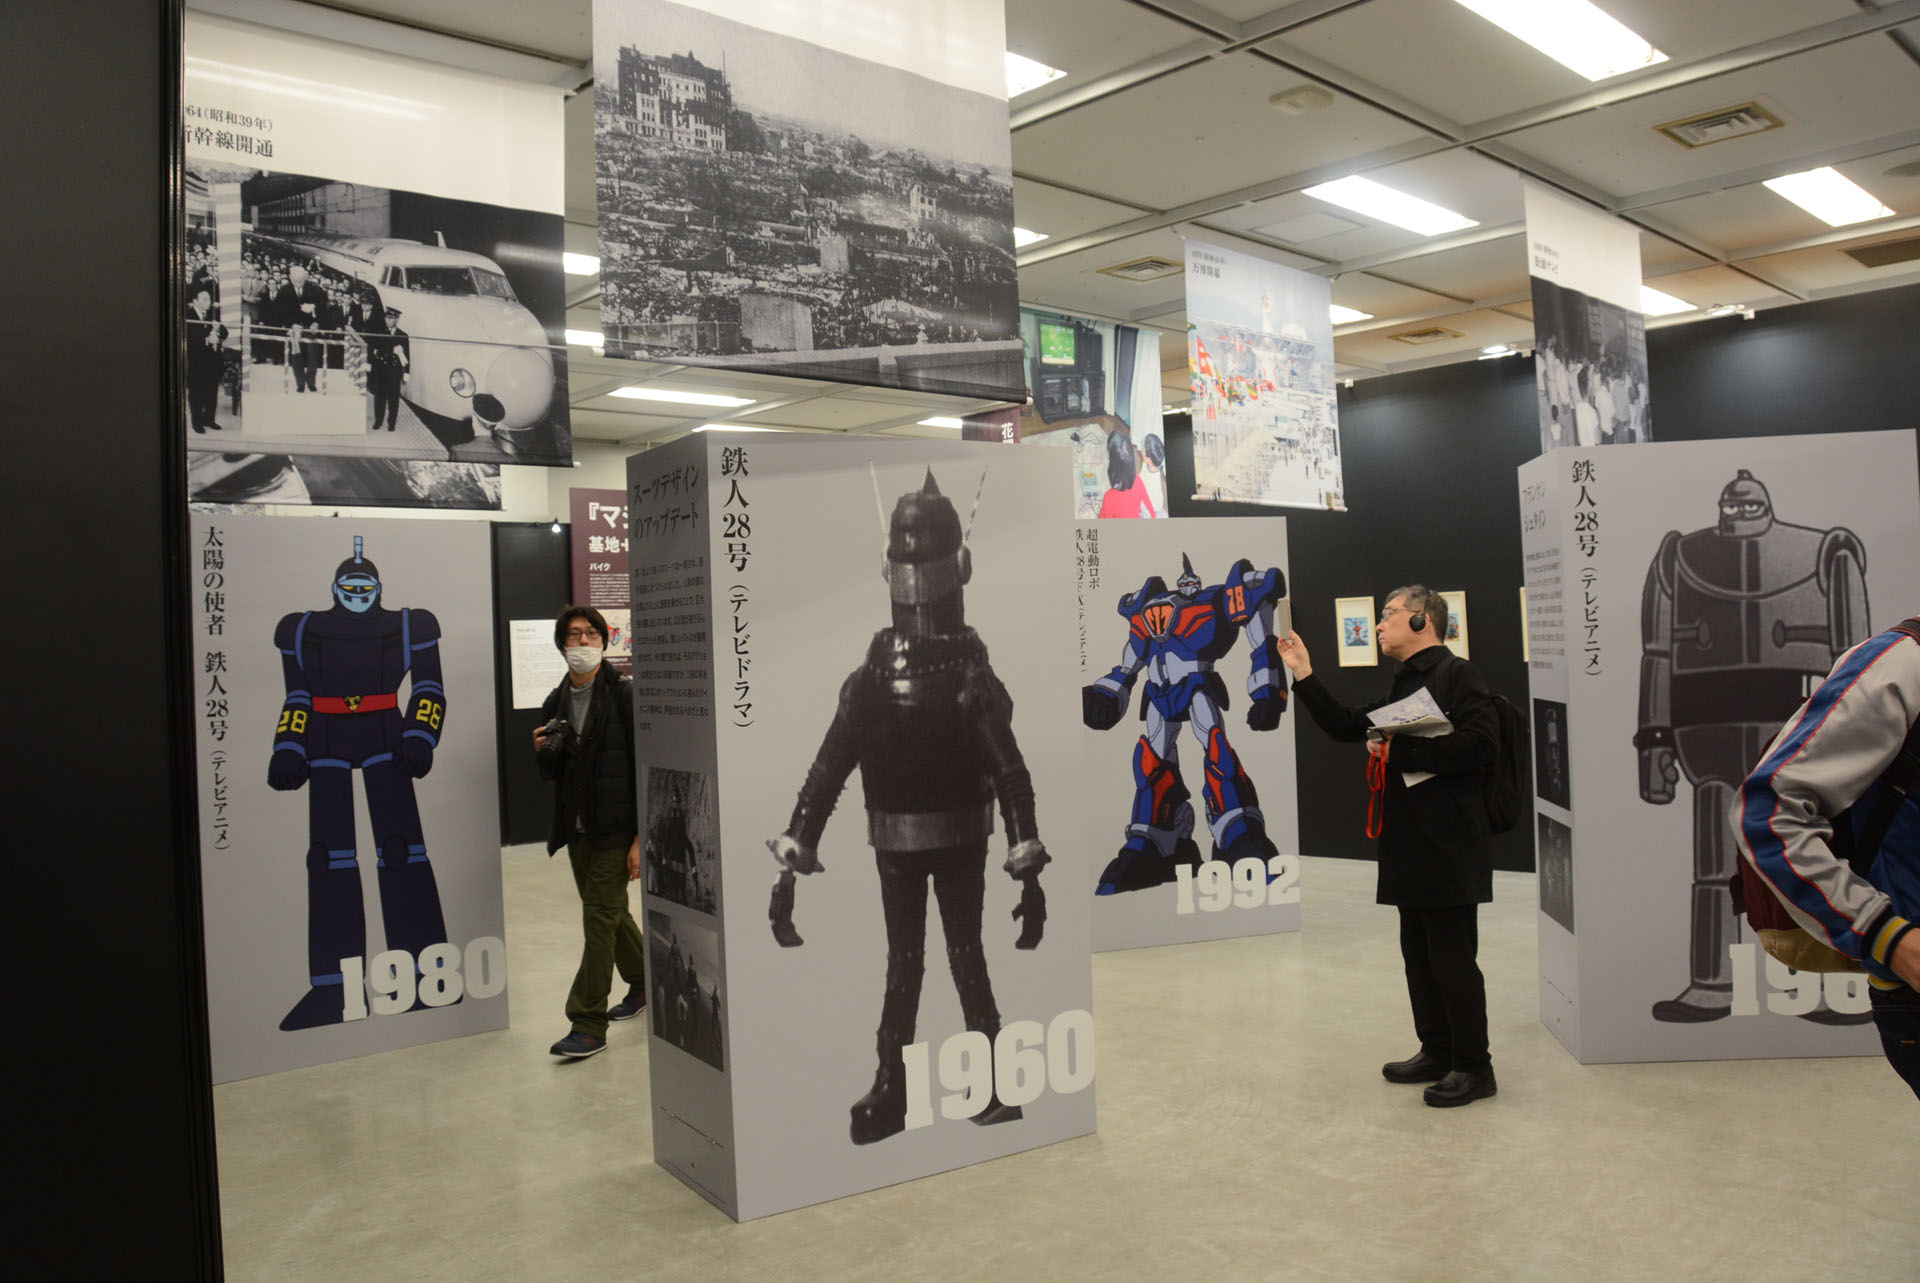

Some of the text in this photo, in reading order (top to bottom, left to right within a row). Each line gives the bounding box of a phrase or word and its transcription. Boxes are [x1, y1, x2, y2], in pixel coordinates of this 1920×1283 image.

[185, 104, 273, 131] 64（昭和39年）
[1001, 422, 1015, 443] 花
[633, 465, 700, 505] スーツデザイン
[633, 502, 699, 540] のアップデート
[588, 562, 611, 571] バイク
[1087, 528, 1100, 590] 超電動ロボ
[202, 526, 225, 636] 太陽の使者
[276, 709, 308, 734] 28
[415, 698, 443, 730] 28
[1175, 854, 1301, 915] 1992
[339, 936, 507, 1022] 1980
[902, 1009, 1096, 1131] 1960
